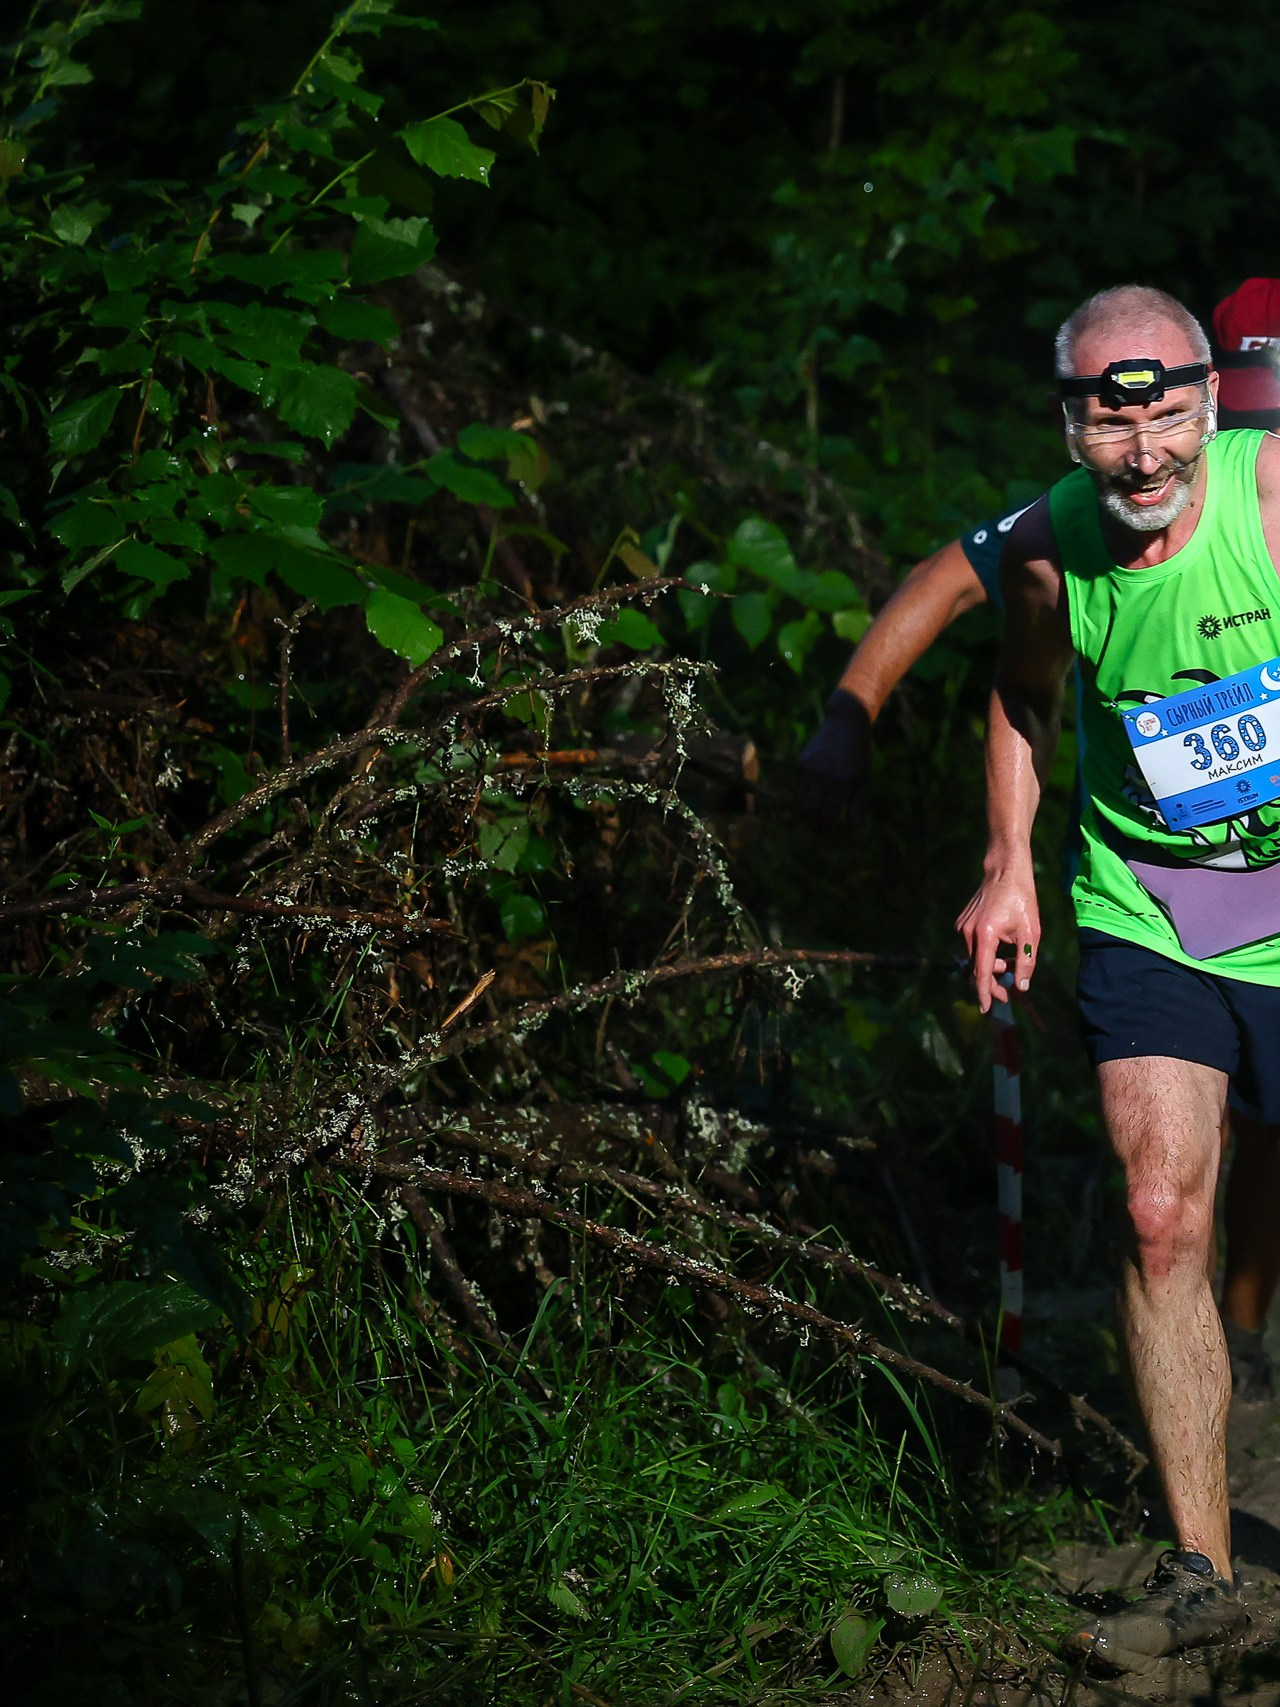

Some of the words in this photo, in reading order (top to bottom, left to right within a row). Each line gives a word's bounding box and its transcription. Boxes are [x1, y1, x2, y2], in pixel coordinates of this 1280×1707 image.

[1222, 607, 1271, 629] ИСТРАН
[1167, 693, 1217, 727] СЫРНЫЙ
[1213, 681, 1255, 711] ТРЕЙЛ
[1183, 714, 1267, 770] 360
[1208, 753, 1264, 780] МАКСИМ
